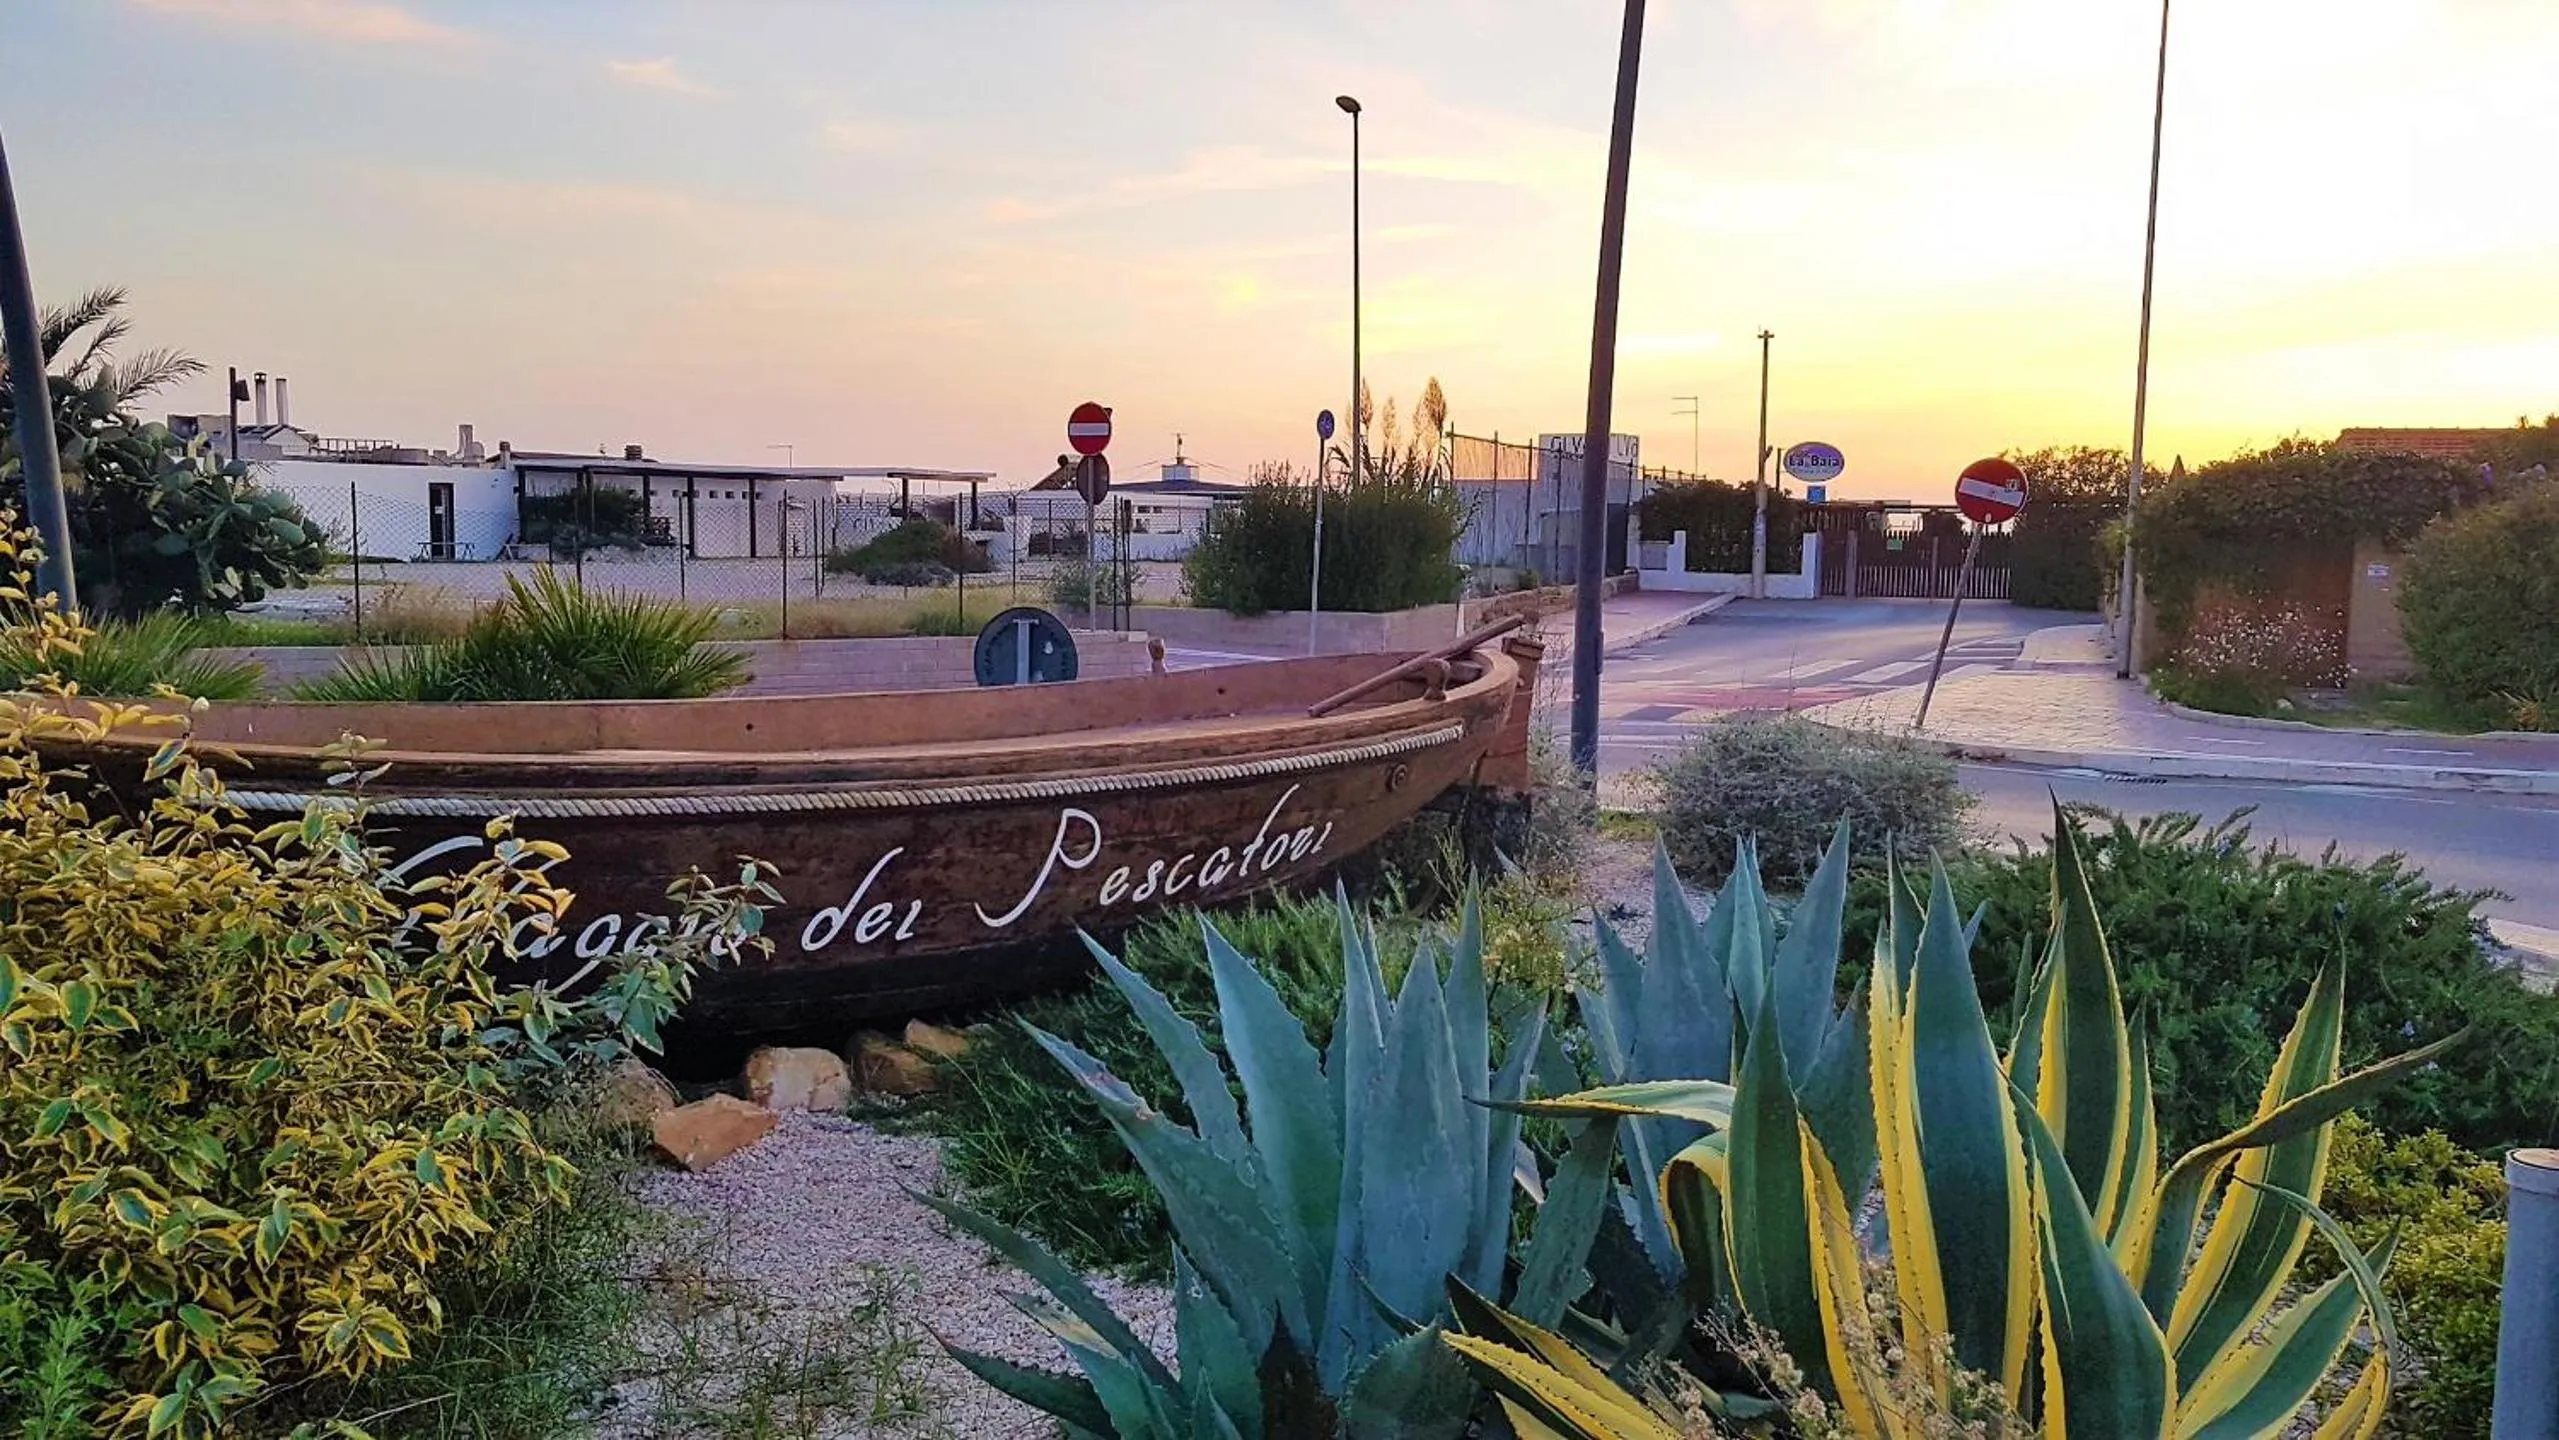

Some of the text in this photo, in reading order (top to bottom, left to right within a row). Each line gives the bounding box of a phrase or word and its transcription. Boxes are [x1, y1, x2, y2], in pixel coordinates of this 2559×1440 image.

[1789, 455, 1840, 467] La Baia
[801, 847, 922, 951] dei
[974, 784, 1333, 928] Pescatori
